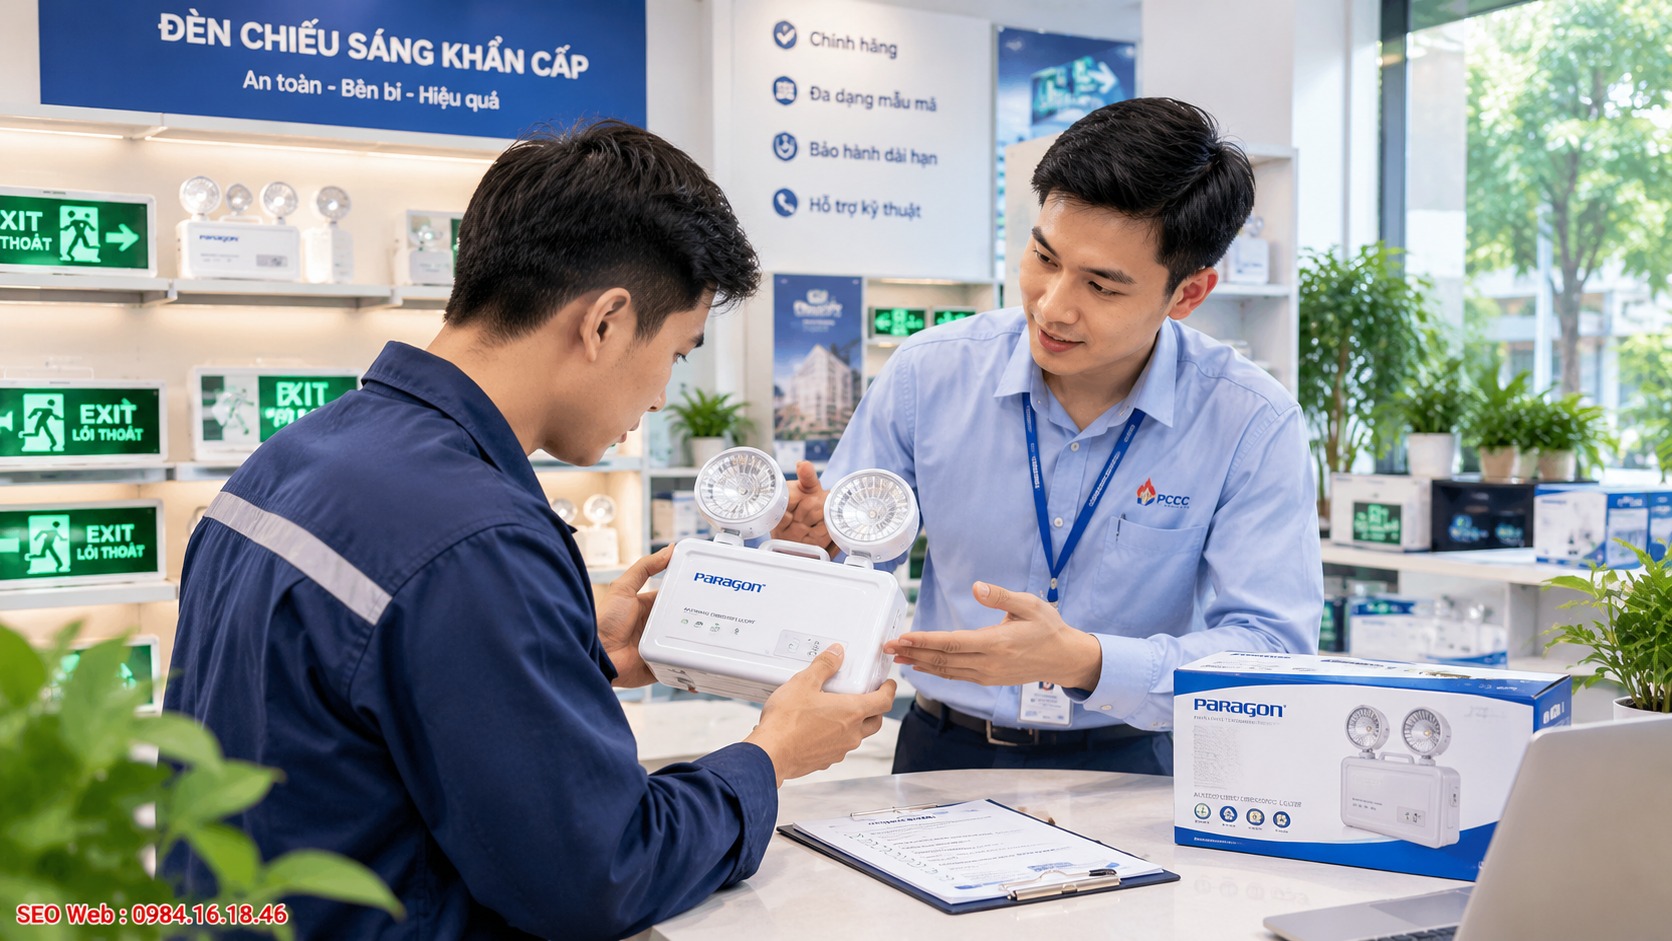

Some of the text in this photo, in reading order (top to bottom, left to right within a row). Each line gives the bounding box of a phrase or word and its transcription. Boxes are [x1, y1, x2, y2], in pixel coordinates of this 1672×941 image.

[158, 8, 590, 80] ĐÈN CHIẾU SÁNG KHẨN CẤP
[242, 69, 272, 91] An
[341, 78, 379, 100] Bền
[419, 85, 461, 110] Hiệu
[809, 85, 831, 102] Đa
[835, 88, 874, 110] dạng
[910, 149, 939, 169] hạn
[809, 194, 832, 214] Hỗ
[835, 199, 858, 218] trợ
[79, 403, 137, 425] EXIT
[1156, 493, 1191, 506] PCCC
[86, 522, 135, 544] EXIT
